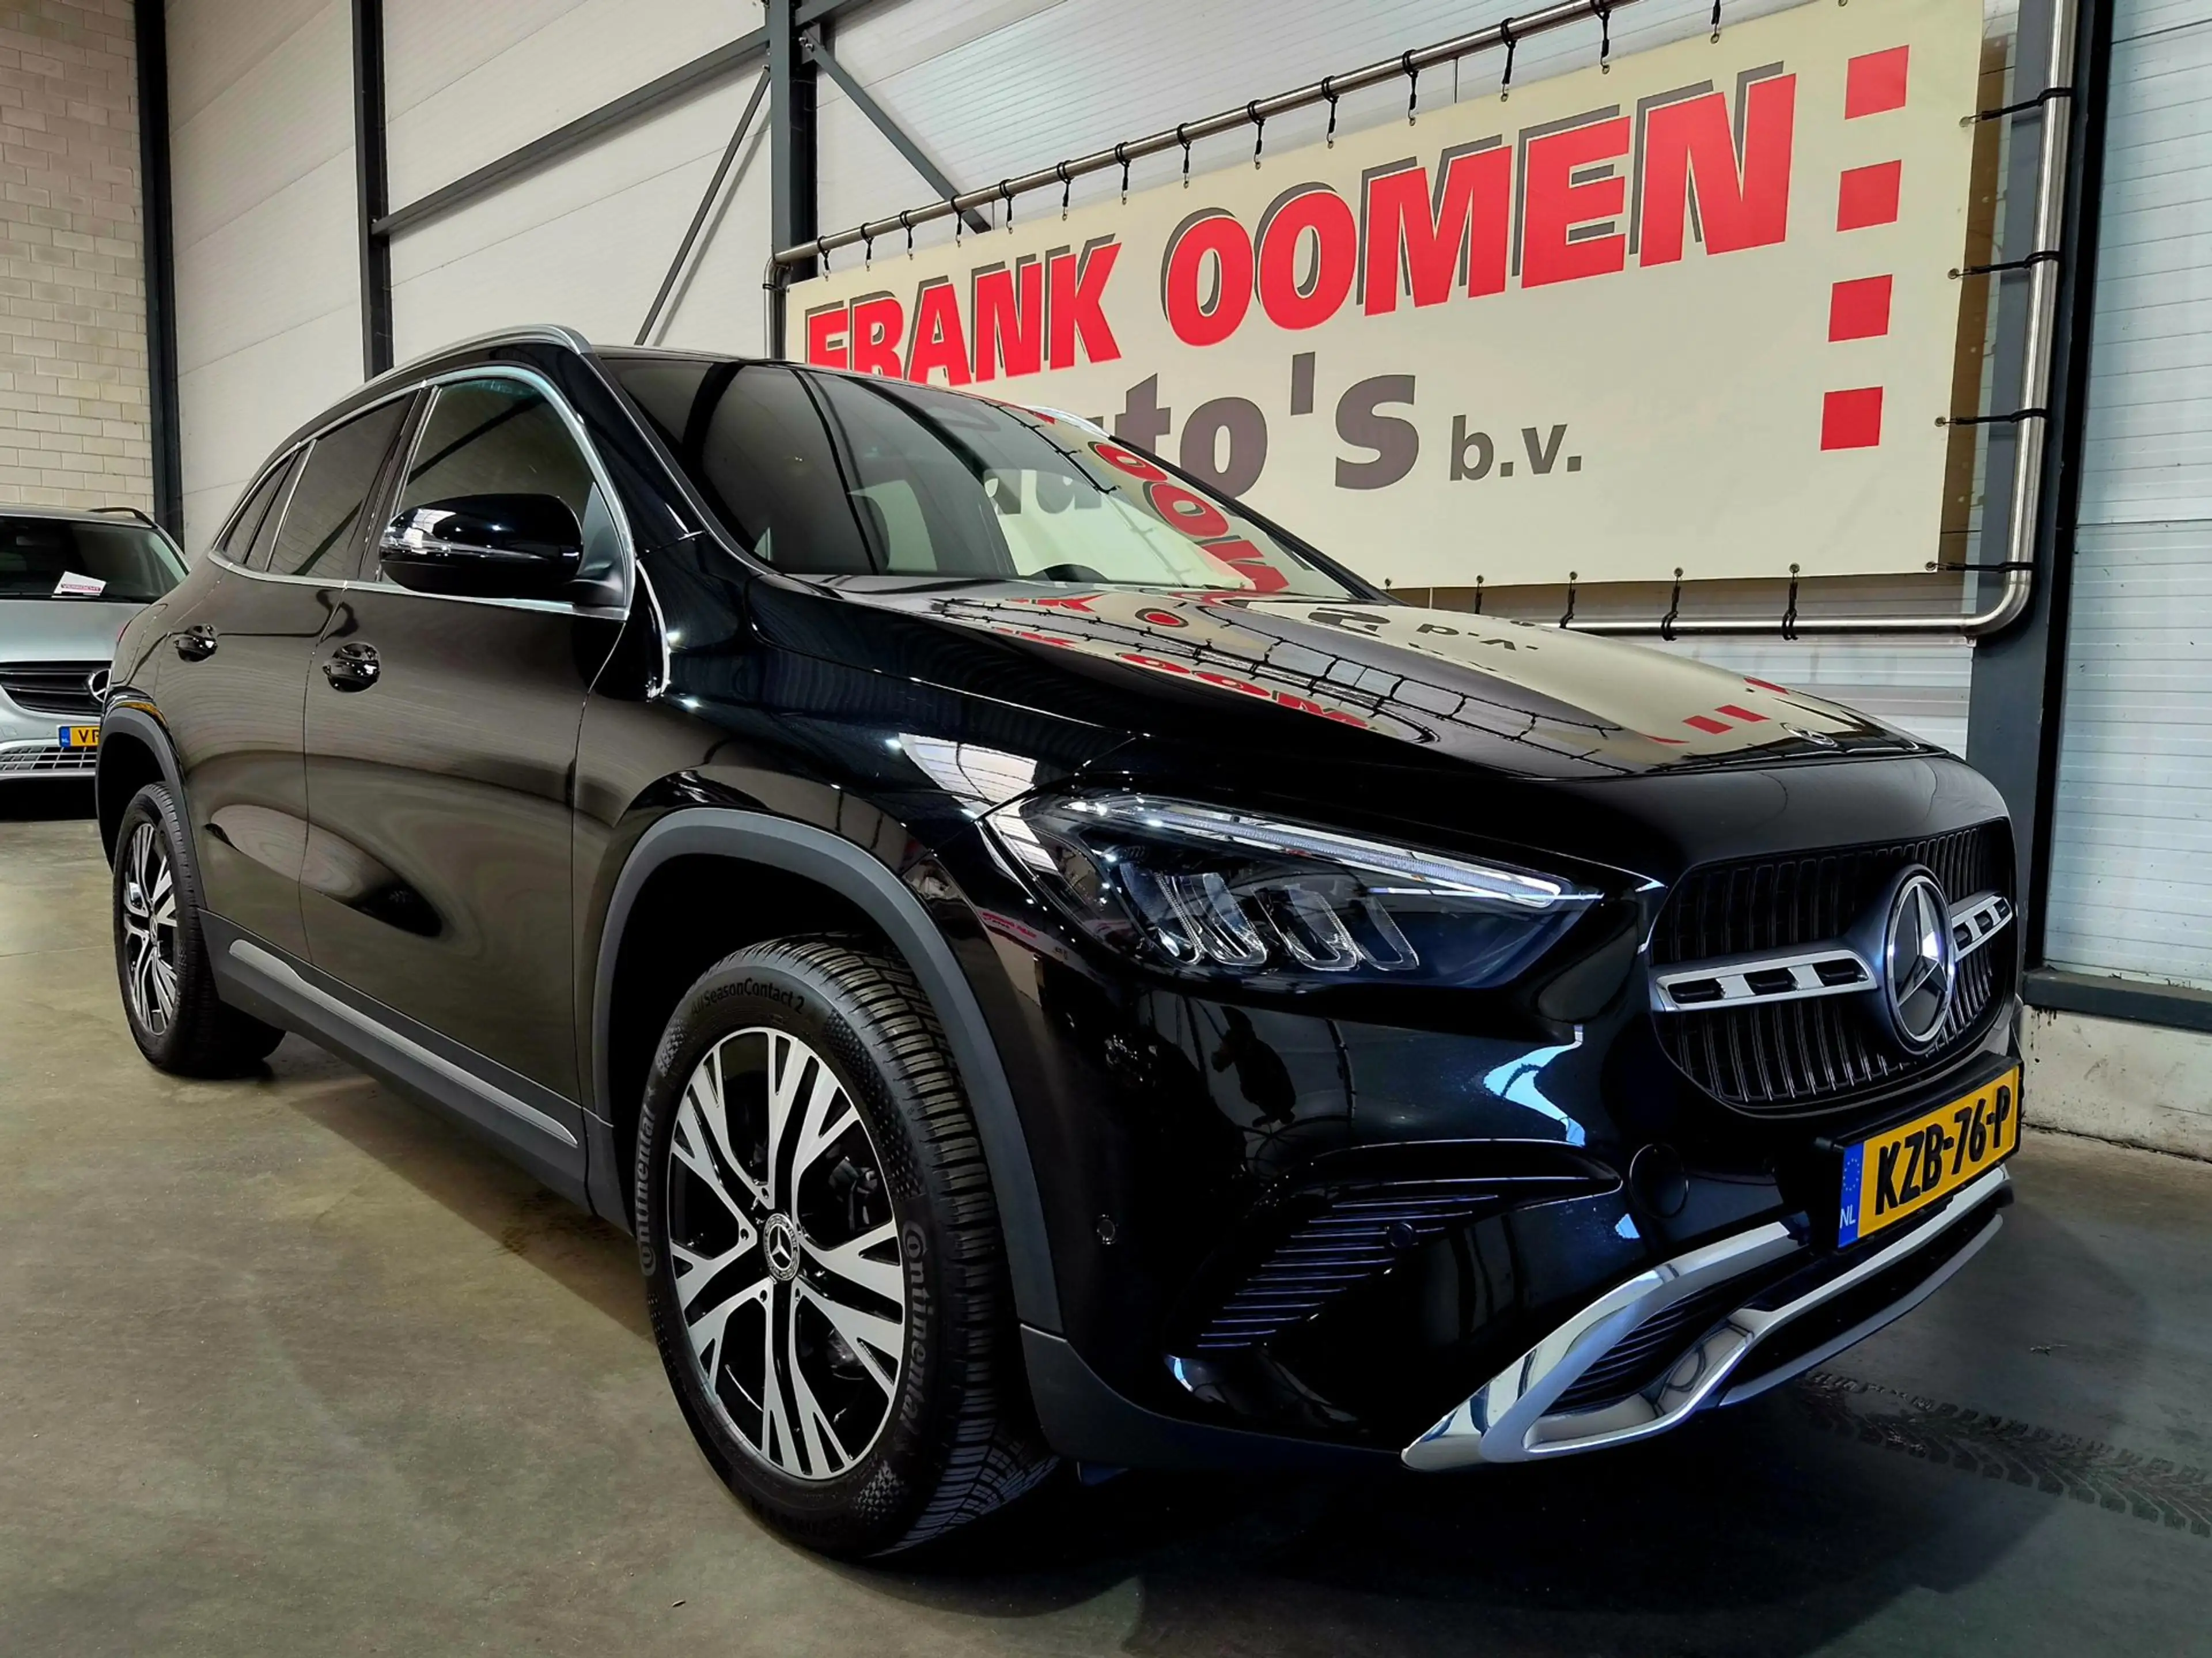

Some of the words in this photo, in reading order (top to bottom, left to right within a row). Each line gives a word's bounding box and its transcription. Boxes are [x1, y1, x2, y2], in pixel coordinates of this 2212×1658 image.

[805, 233, 1122, 387] FRANK
[1161, 60, 1796, 347] OOMEN
[1450, 415, 1583, 482] b.v.
[794, 995, 805, 1015] 2
[635, 1103, 657, 1277] Continental
[1875, 1085, 2012, 1216] KZB-76-P
[1840, 1204, 1857, 1229] NL
[899, 1219, 934, 1435] Continental
